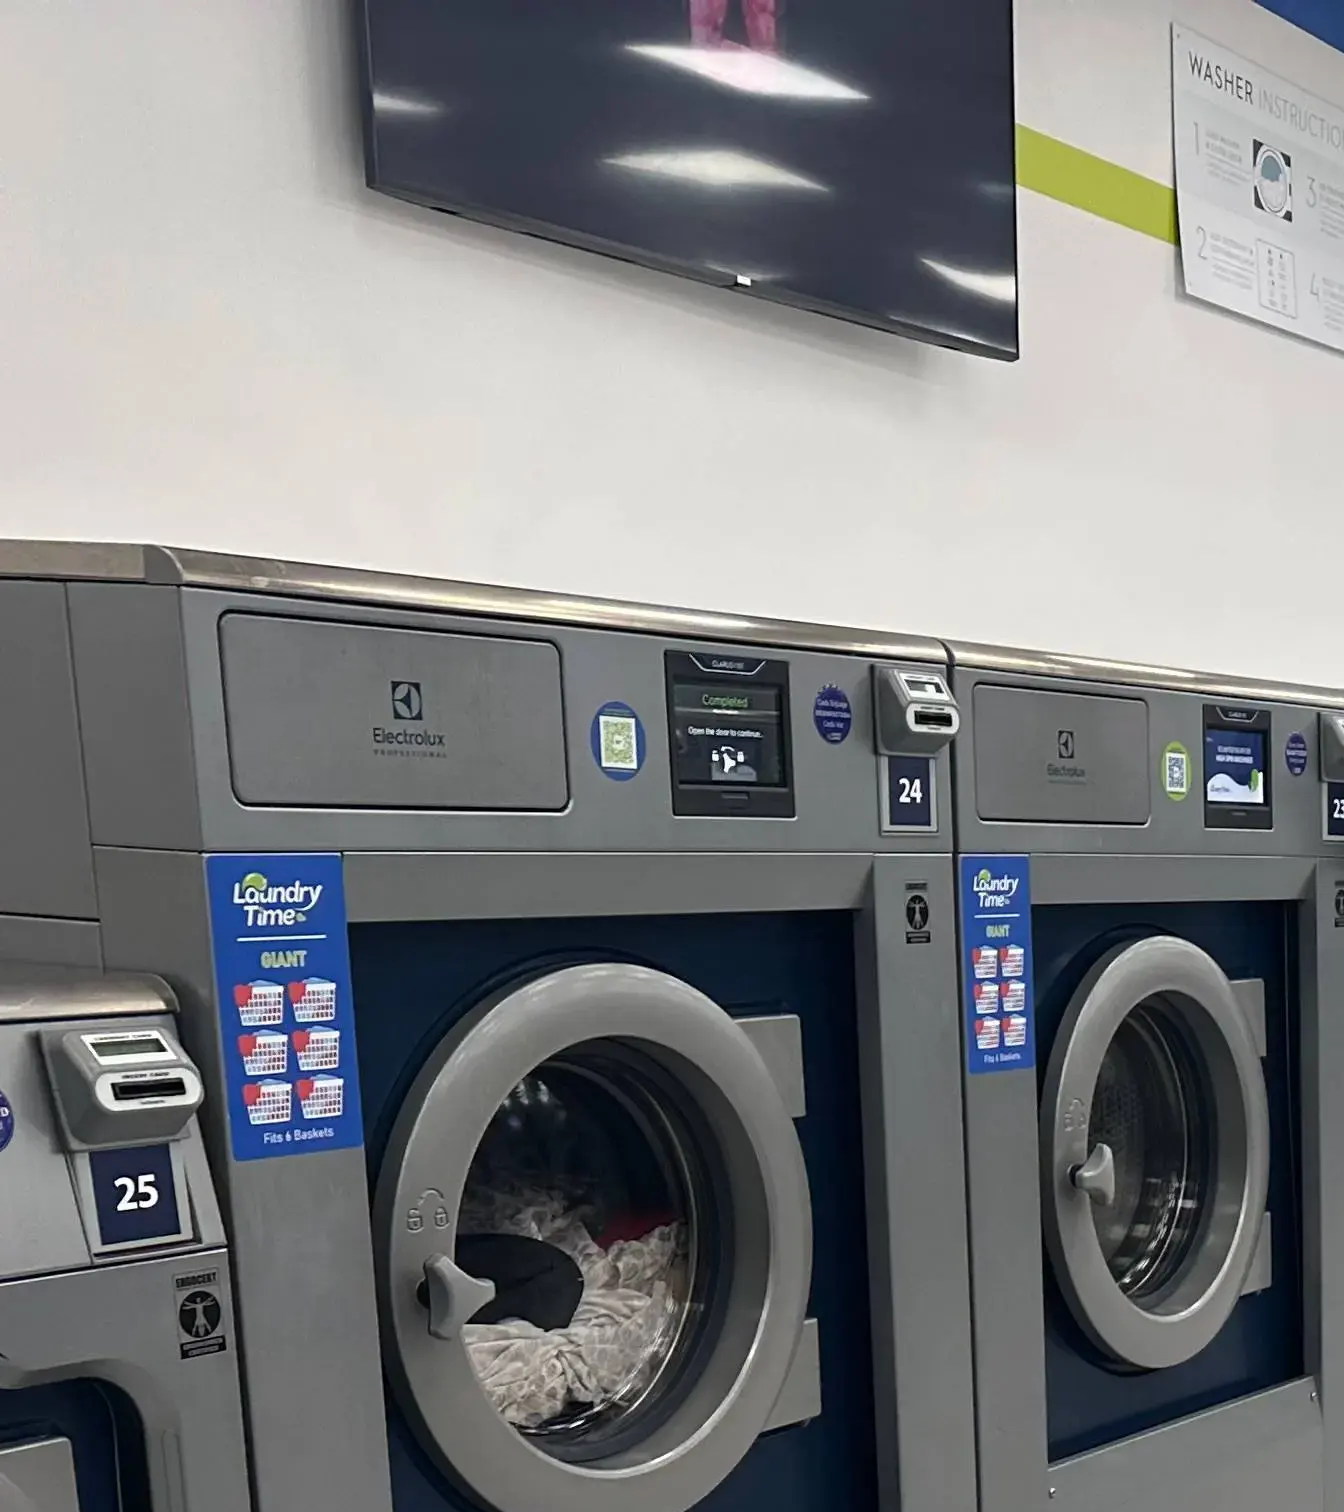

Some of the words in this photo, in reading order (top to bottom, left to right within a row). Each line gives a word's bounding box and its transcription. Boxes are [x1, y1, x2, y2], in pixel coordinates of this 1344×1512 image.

[1188, 50, 1254, 105] WASHER
[1306, 176, 1317, 209] 3
[1196, 226, 1207, 261] 2
[1310, 272, 1320, 303] 4
[373, 727, 446, 747] Electrolux
[898, 778, 922, 804] 24
[233, 879, 323, 911] Laundry
[973, 873, 1019, 897] Laundry
[978, 893, 1005, 908] Time
[244, 905, 295, 927] Time
[260, 950, 308, 969] GIANT
[264, 1130, 283, 1144] Fits
[294, 1127, 335, 1141] Baskets
[114, 1174, 159, 1212] 25
